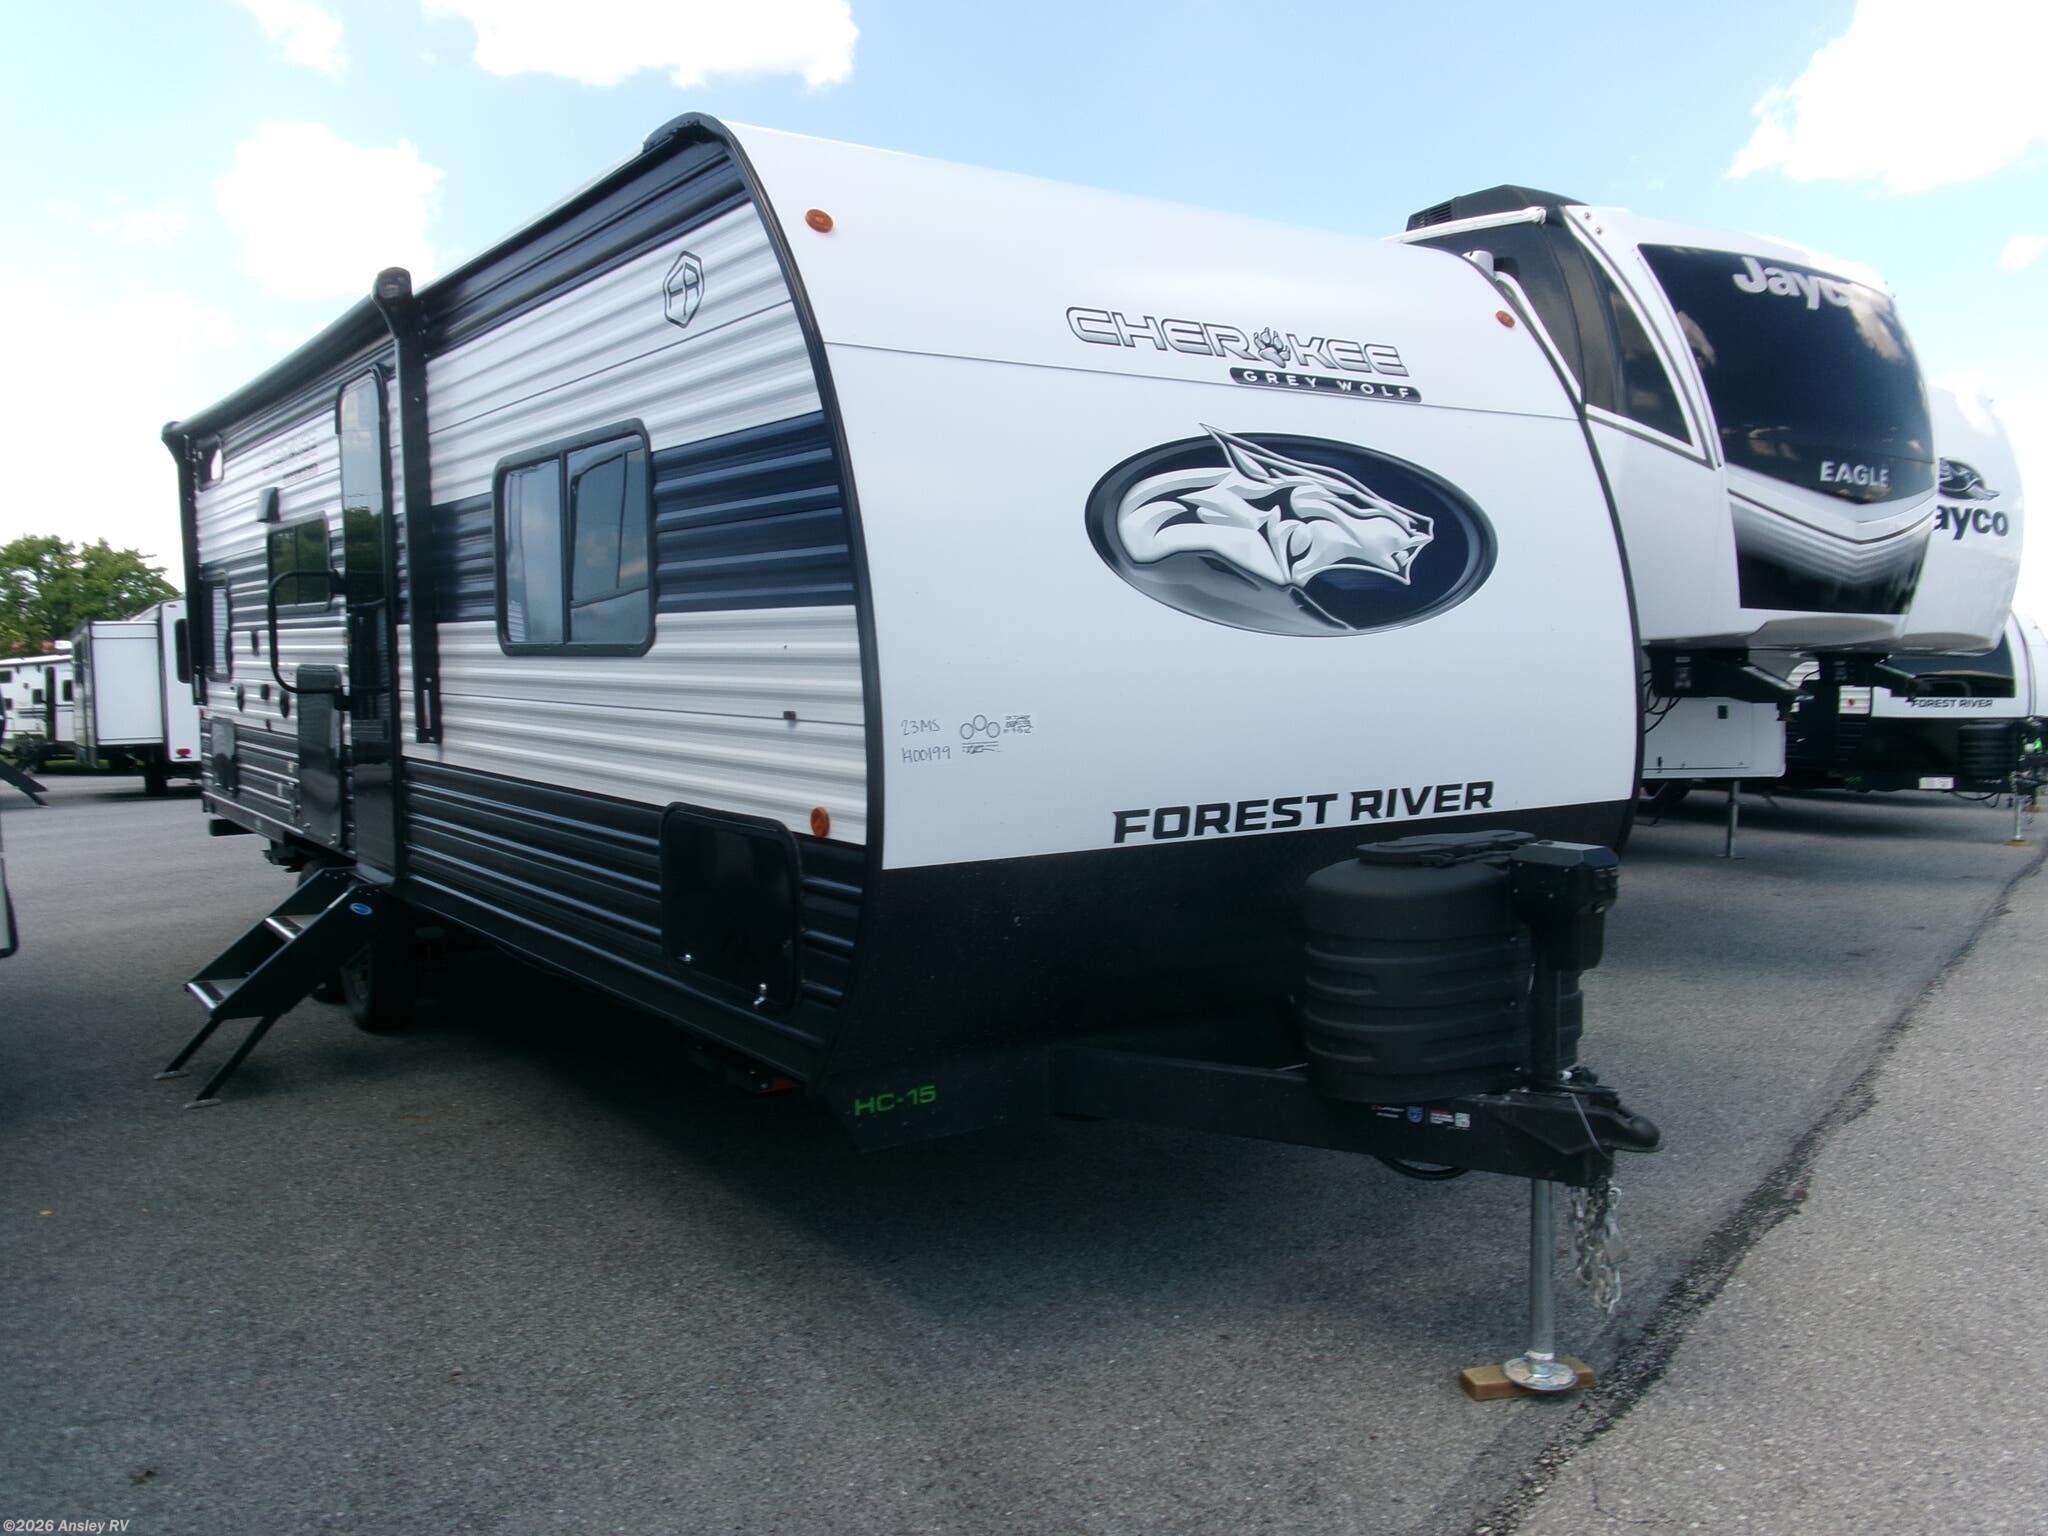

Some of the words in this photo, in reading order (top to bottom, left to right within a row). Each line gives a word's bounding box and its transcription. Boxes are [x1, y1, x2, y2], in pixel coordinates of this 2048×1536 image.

[1732, 256, 1870, 311] Jayc
[1066, 306, 1410, 377] CHEROKEE
[1242, 369, 1319, 389] GREY
[1336, 379, 1410, 399] WOLF
[1820, 461, 1889, 488] EAGLE
[1933, 504, 2009, 541] ayco
[1911, 699, 1957, 709] FOREST
[1958, 699, 1994, 709] RIVER
[900, 718, 941, 736] 23MS
[1112, 793, 1339, 844] FOREST
[1349, 780, 1494, 822] RIVER
